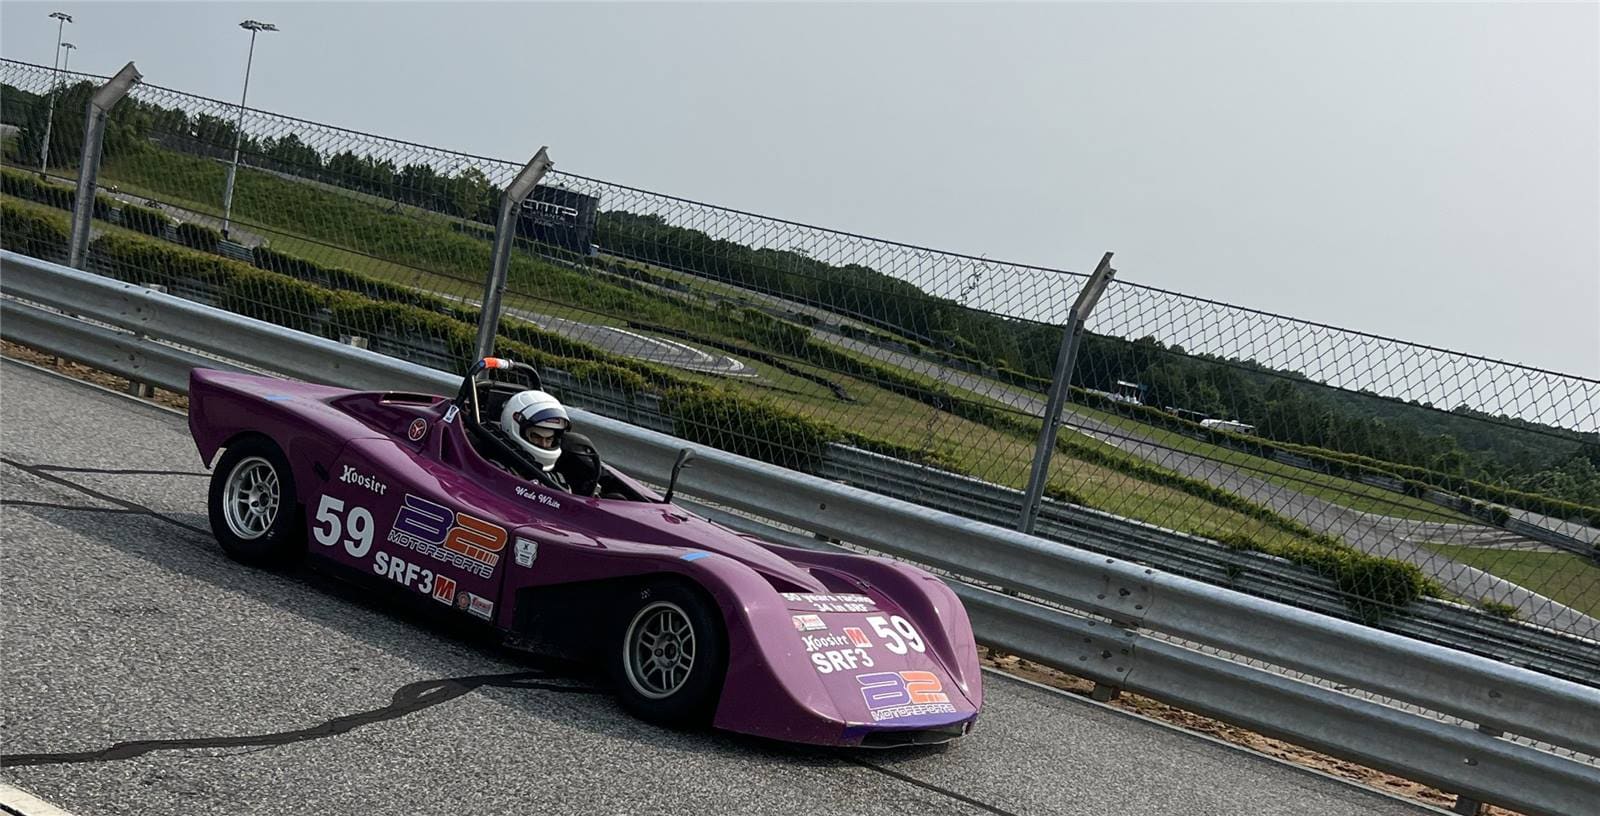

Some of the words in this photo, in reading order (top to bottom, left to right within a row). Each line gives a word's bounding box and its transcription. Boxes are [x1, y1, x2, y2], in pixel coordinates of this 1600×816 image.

[340, 464, 387, 496] Hoosier
[313, 494, 375, 558] 59
[373, 551, 433, 594] SRF3
[387, 530, 494, 580] MOTORSPORTS
[801, 634, 850, 652] Hoosier
[866, 615, 926, 655] 59
[811, 649, 875, 674] SRF3
[870, 703, 957, 721] MOTORSPORTS
